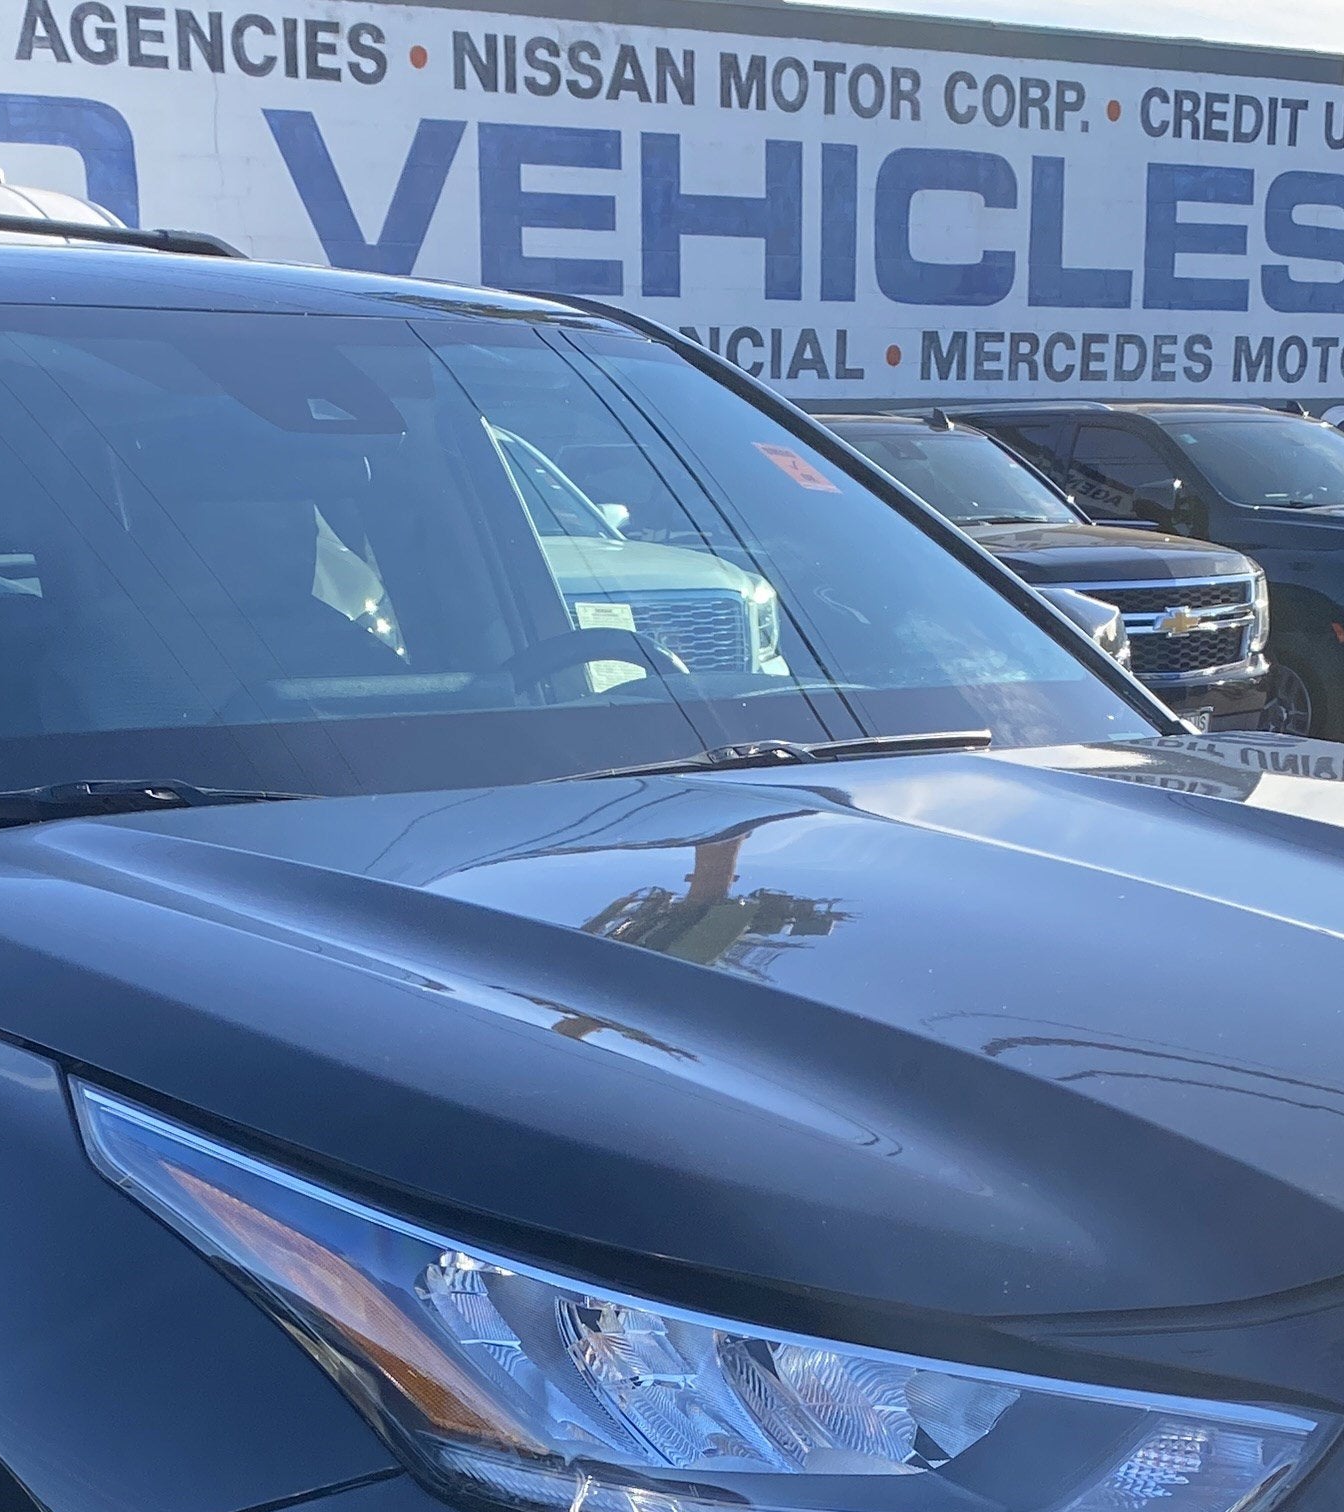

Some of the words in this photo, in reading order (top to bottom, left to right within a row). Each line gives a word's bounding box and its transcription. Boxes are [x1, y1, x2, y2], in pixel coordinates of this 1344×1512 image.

[15, 0, 387, 85] AGENCIES
[452, 30, 697, 106] NISSAN
[719, 53, 923, 121] MOTOR
[944, 70, 1090, 133] CORP.
[1140, 86, 1309, 148] CREDIT
[920, 330, 1213, 383] MERCEDES
